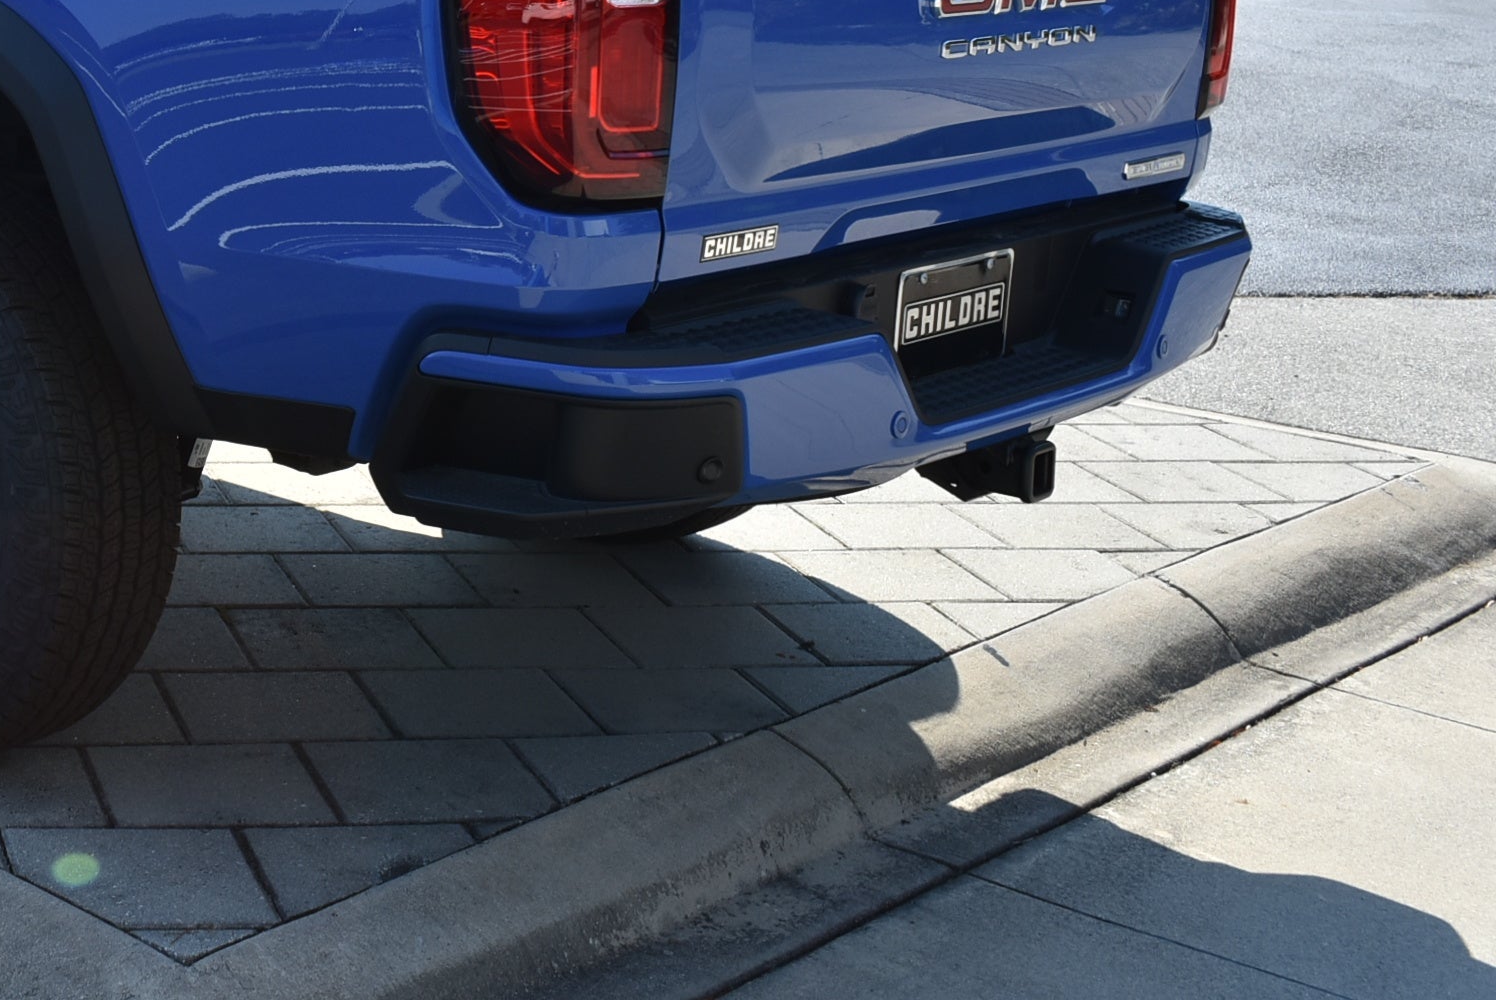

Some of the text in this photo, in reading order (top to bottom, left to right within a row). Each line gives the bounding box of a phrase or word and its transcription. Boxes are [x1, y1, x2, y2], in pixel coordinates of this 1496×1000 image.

[940, 25, 1097, 59] CANYON
[704, 228, 776, 258] CHILDRE
[905, 287, 1002, 340] CHILDRE
